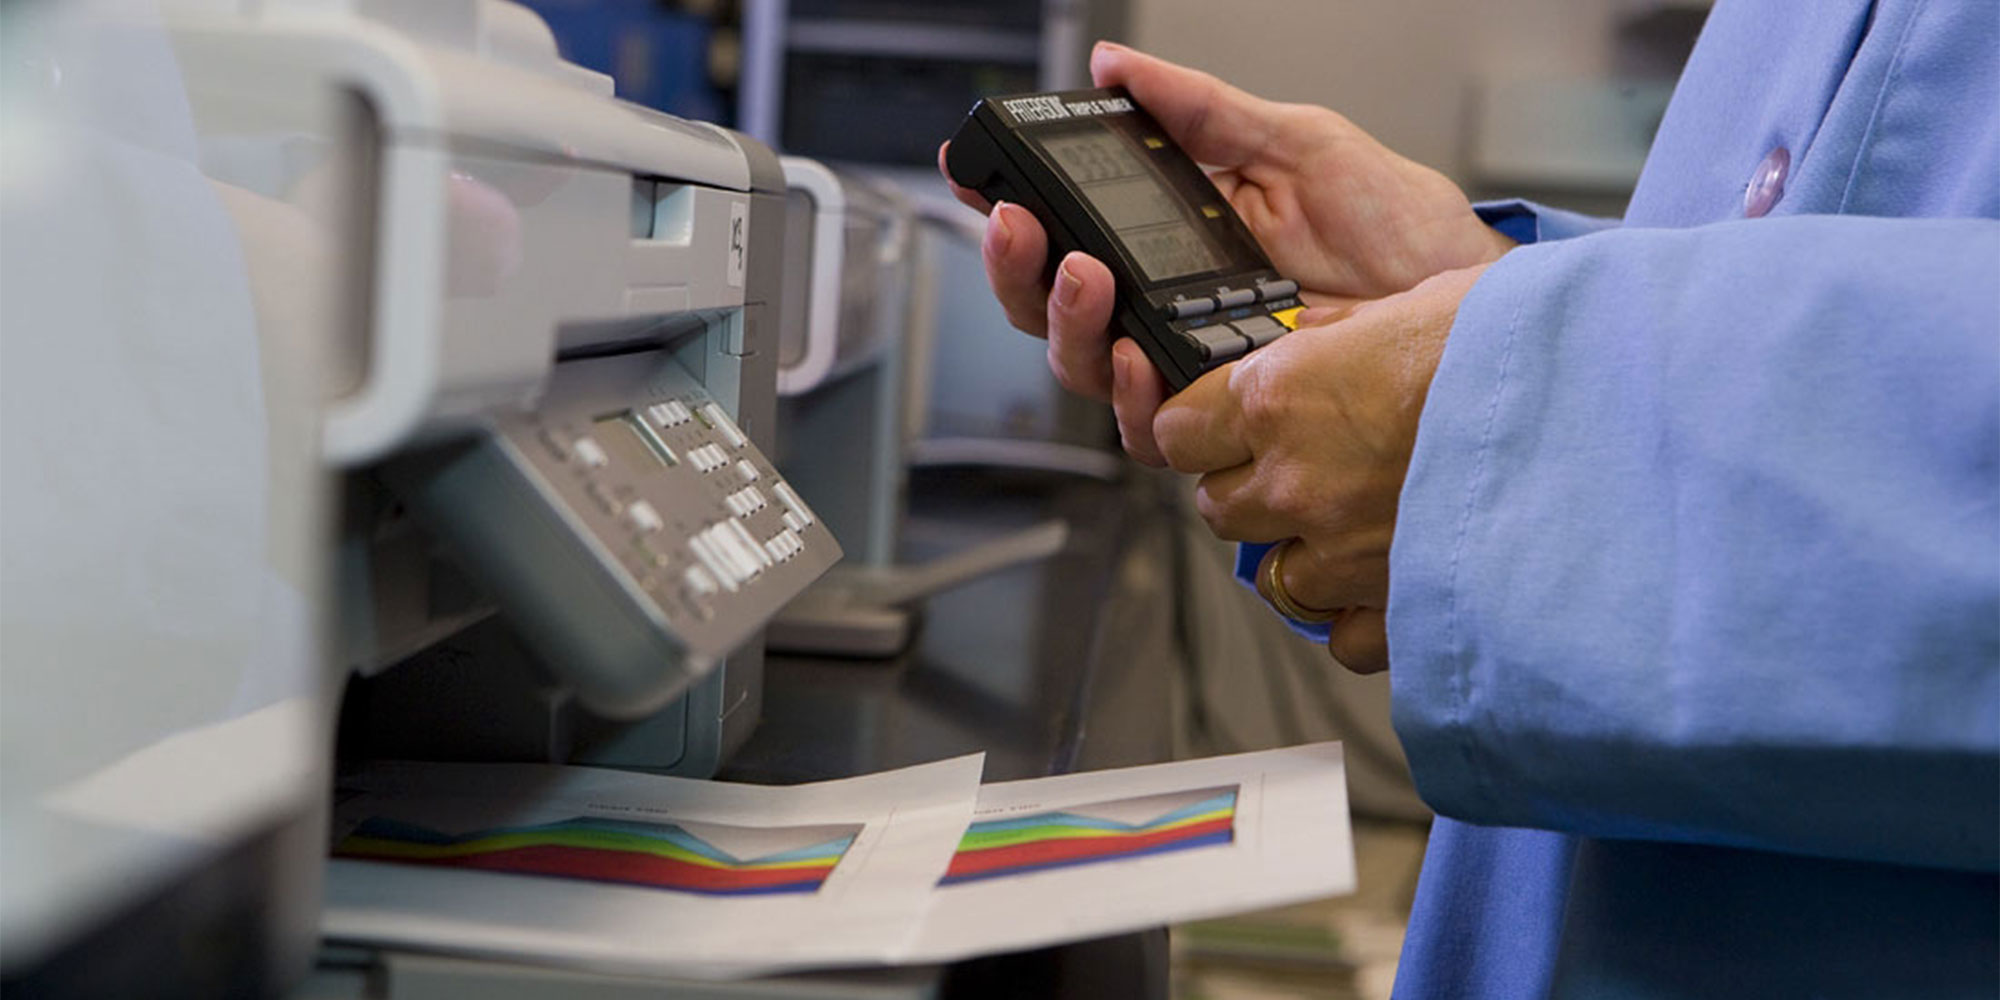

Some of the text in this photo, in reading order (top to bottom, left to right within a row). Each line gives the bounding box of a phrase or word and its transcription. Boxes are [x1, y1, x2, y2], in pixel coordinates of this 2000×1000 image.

[1002, 96, 1135, 123] PATERSON TRIPLE TIMER
